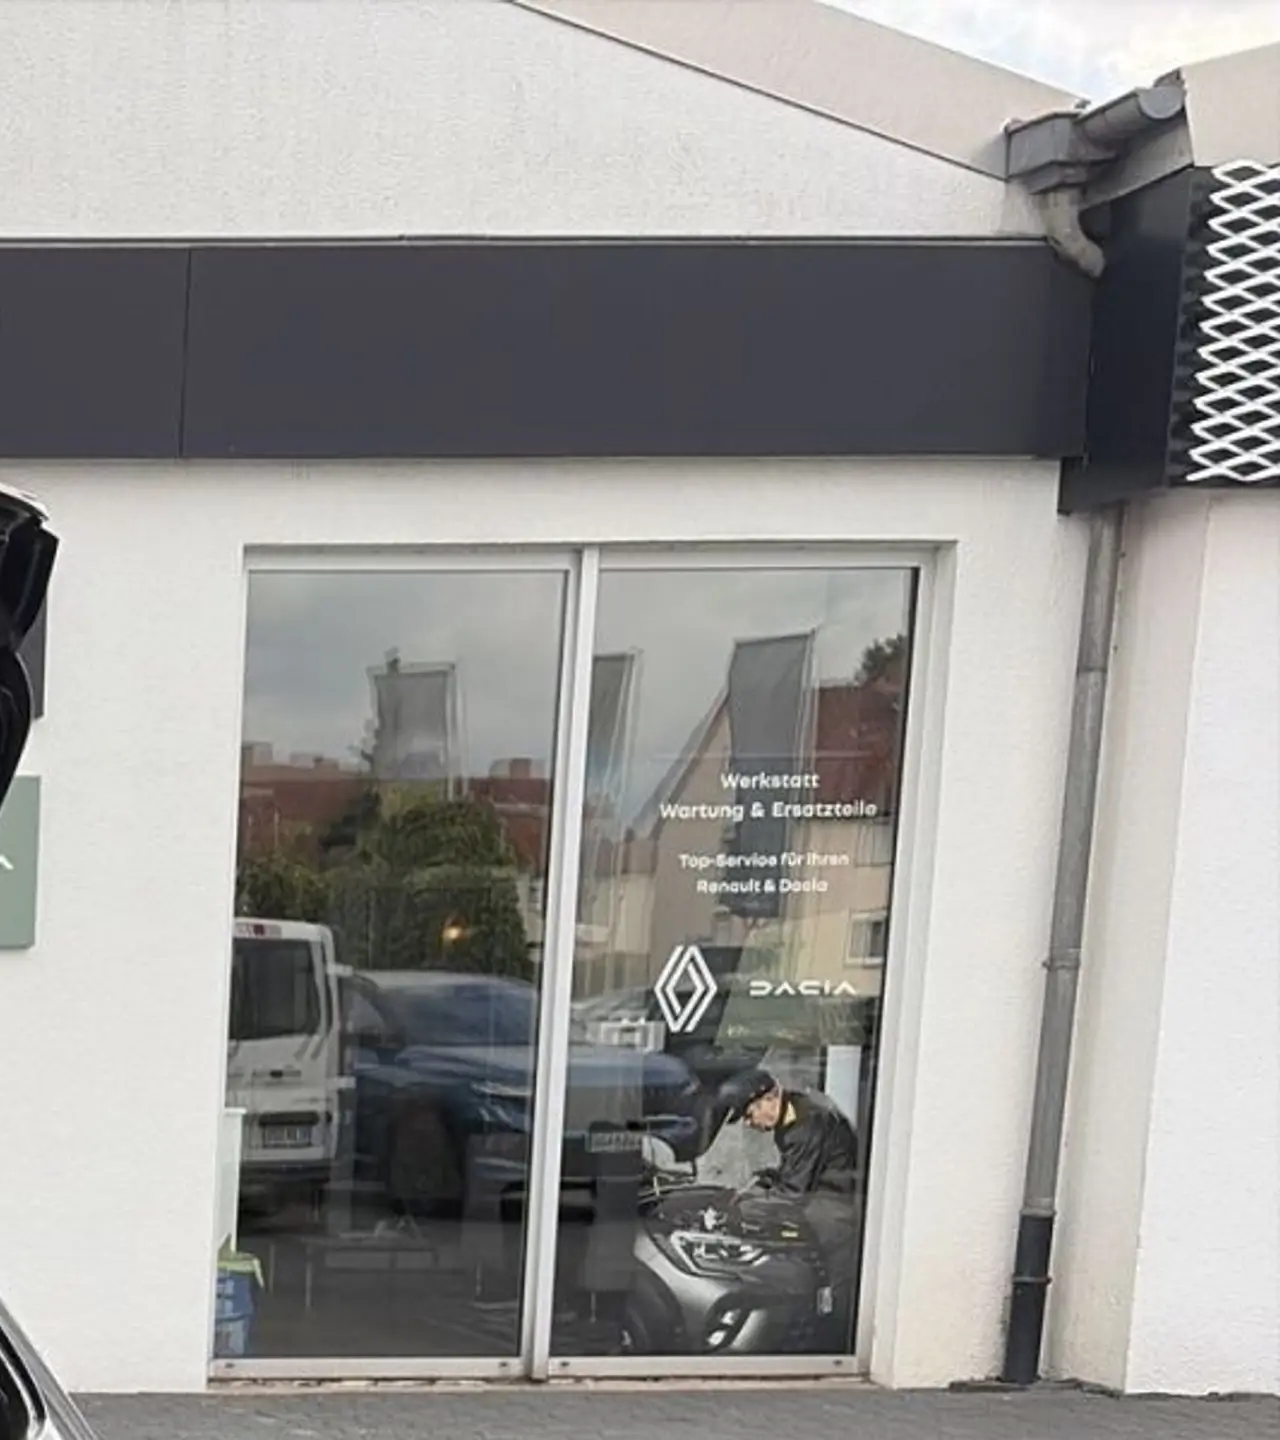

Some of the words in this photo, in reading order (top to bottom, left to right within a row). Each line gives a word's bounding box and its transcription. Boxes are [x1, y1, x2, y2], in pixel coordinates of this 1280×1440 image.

[721, 772, 820, 789] Werkstatt
[659, 802, 744, 822] Wartung
[749, 801, 765, 818] &
[772, 799, 878, 818] Ersatzteile
[678, 852, 777, 869] Top-Service
[780, 851, 806, 868] für
[807, 851, 850, 867] Ihren
[696, 879, 761, 893] Renault
[764, 879, 776, 893] &
[779, 878, 829, 892] Dacia
[749, 979, 858, 997] DACIA
